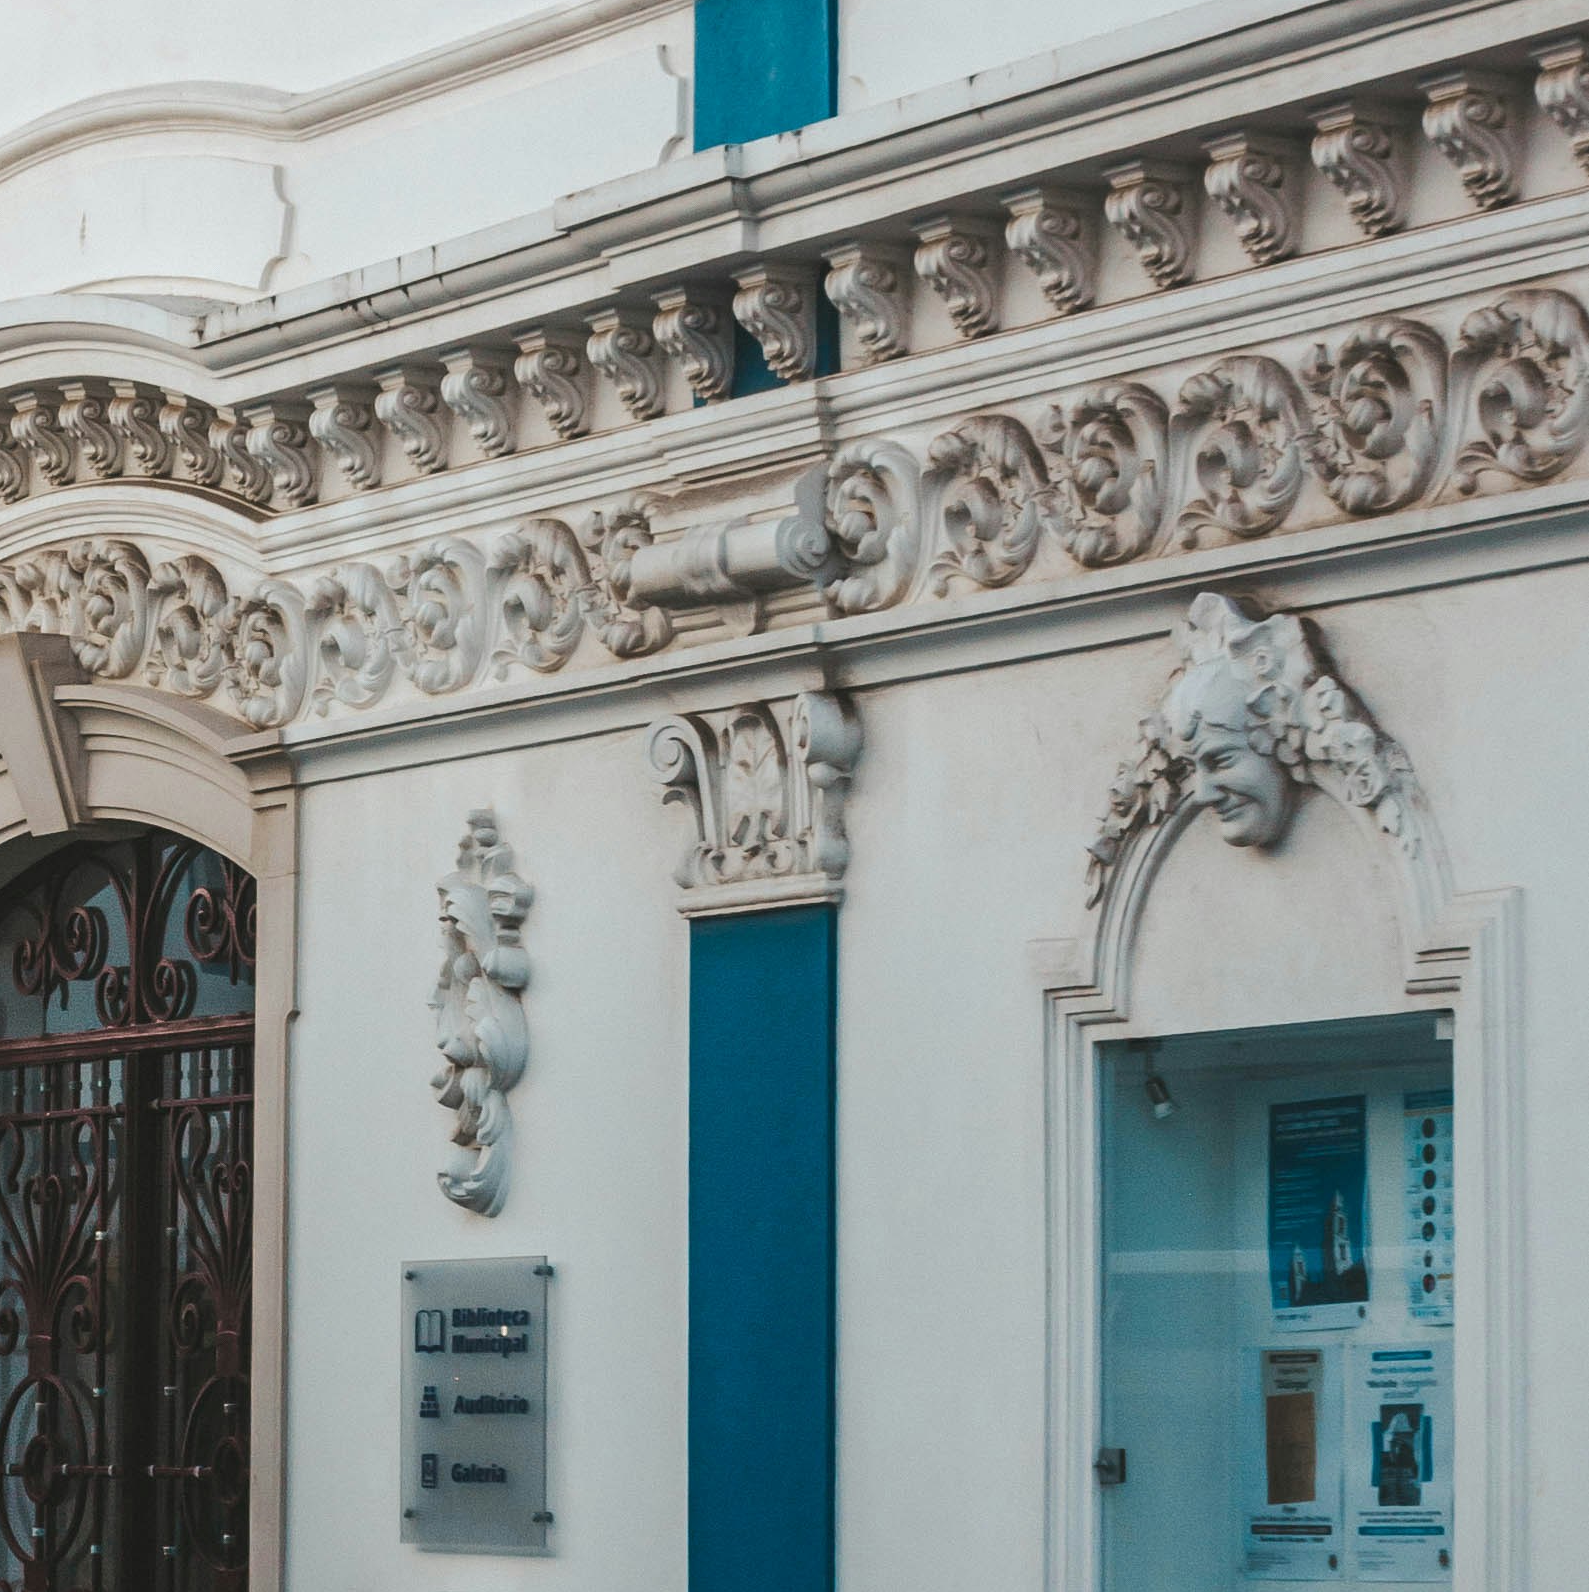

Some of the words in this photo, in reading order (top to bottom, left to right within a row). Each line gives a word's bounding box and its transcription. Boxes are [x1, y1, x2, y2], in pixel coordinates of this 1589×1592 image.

[451, 1307, 530, 1327] Biblioteca
[451, 1334, 529, 1358] Municipal
[453, 1393, 529, 1414] Auditório
[451, 1463, 508, 1483] Galeria
